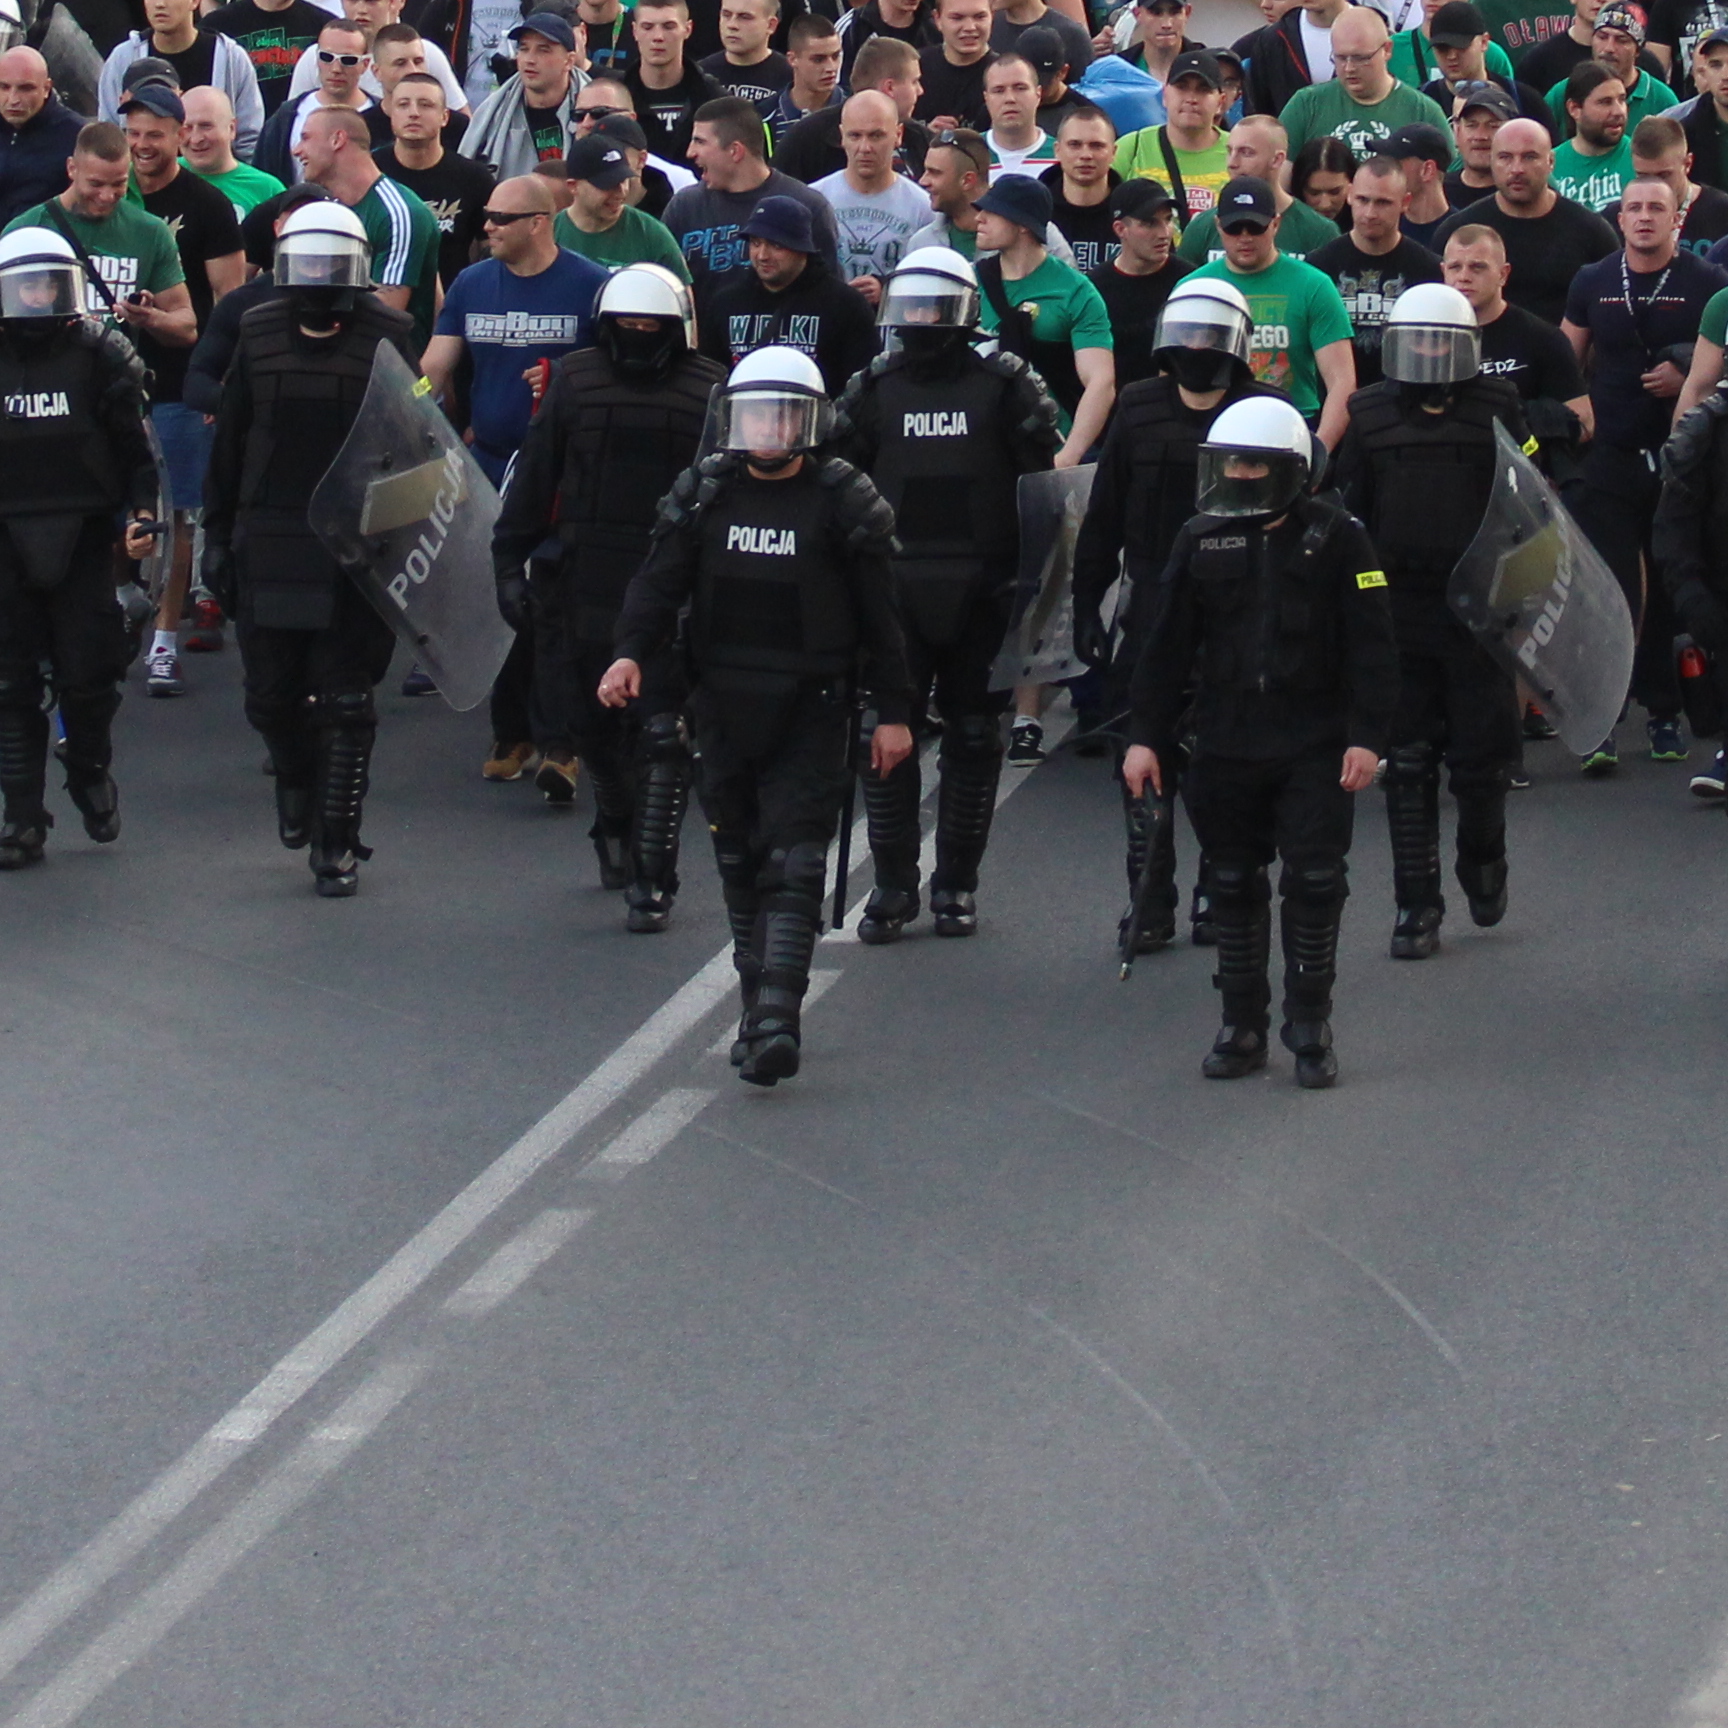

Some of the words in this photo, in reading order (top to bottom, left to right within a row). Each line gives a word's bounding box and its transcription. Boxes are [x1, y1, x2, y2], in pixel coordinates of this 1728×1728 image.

[1503, 14, 1577, 48] OŁAW
[904, 412, 967, 437] POLICJA
[385, 446, 465, 612] POLICJA
[727, 526, 796, 556] POLICJA
